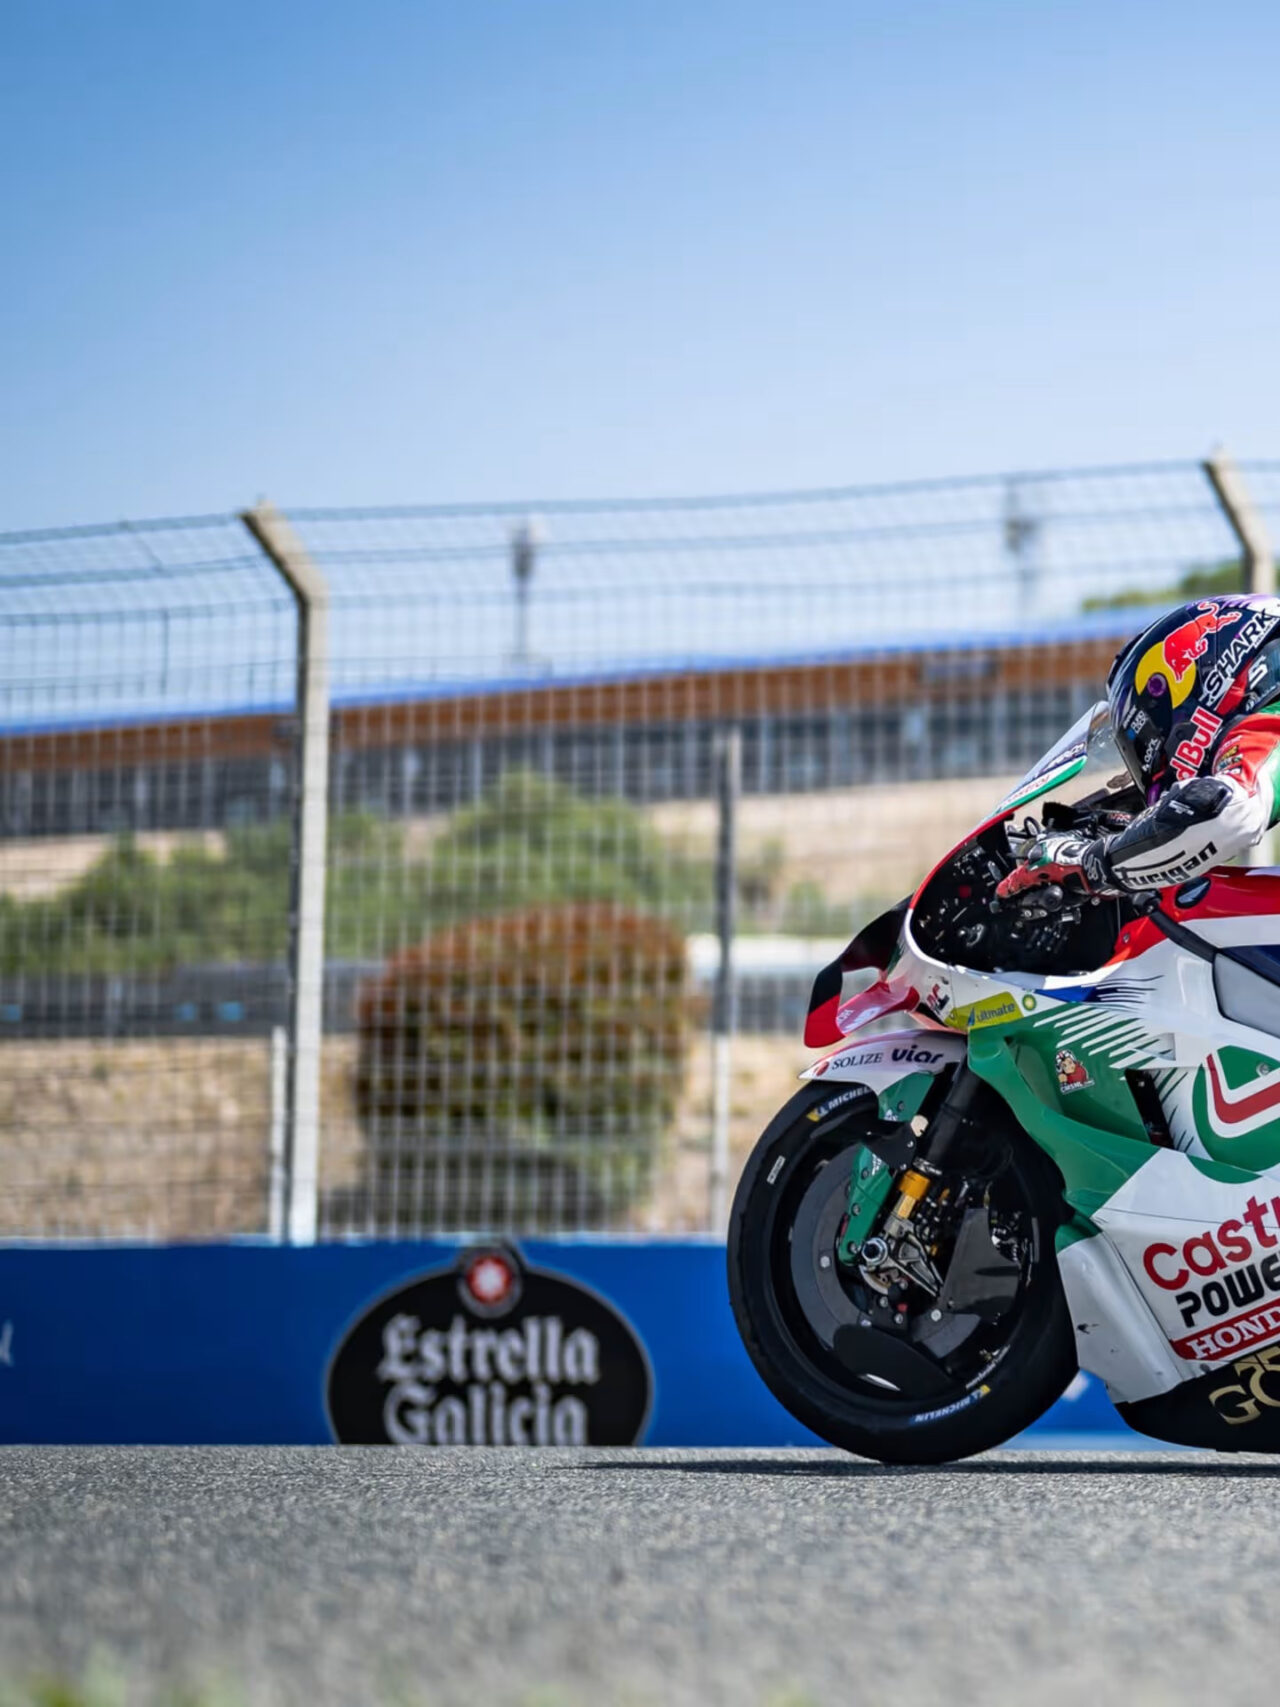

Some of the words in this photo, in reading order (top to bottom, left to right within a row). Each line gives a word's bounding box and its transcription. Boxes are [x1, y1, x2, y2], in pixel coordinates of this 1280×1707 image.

[1204, 608, 1274, 700] SHARK
[832, 1052, 883, 1070] SOLIZE
[828, 1086, 871, 1108] MICHEL
[376, 1313, 600, 1386] Estrella
[384, 1379, 588, 1446] Galicia
